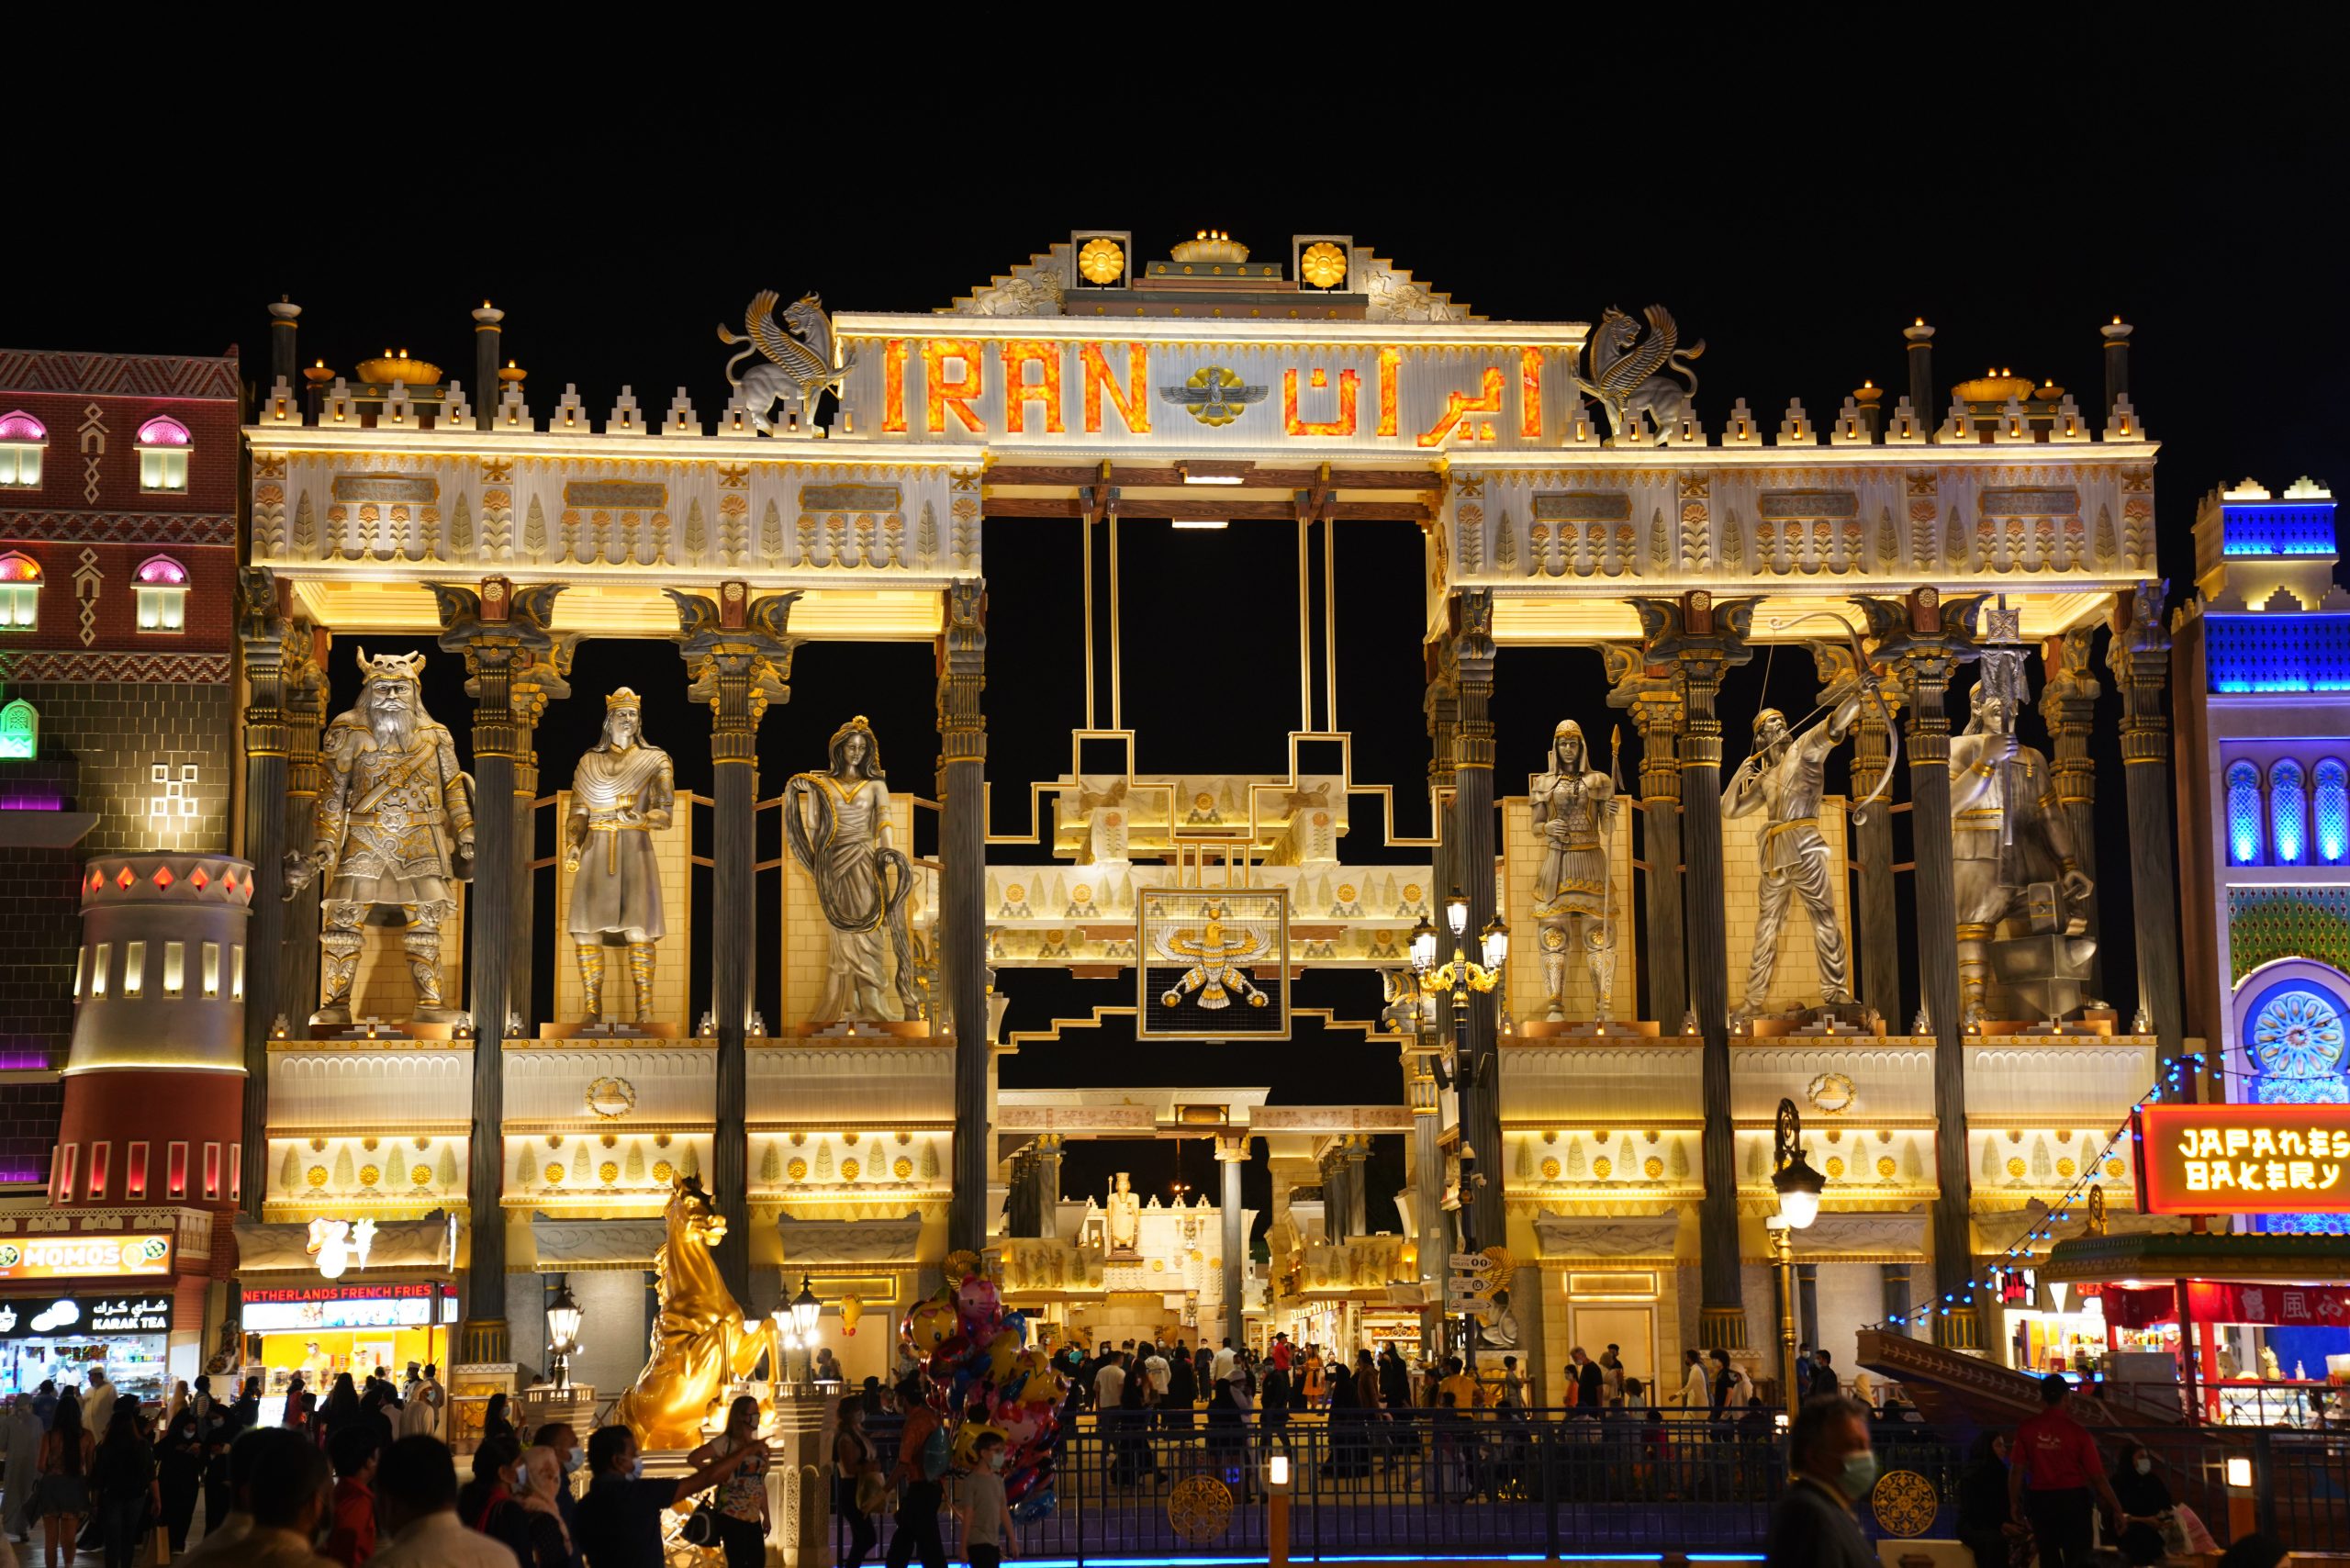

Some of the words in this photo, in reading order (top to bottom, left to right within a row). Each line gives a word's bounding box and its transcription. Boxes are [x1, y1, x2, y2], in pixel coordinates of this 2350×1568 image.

[882, 340, 1152, 433] IRAN
[2185, 1159, 2340, 1191] BAKERY
[23, 1247, 120, 1267] MOMOS
[242, 1288, 338, 1302] NETHERLANDS
[341, 1286, 391, 1299] FRENCH
[395, 1284, 431, 1297] FRIES
[93, 1300, 129, 1316] كرك
[130, 1299, 168, 1317] شاي
[92, 1317, 139, 1330] KARAK
[140, 1316, 167, 1329] TEA
